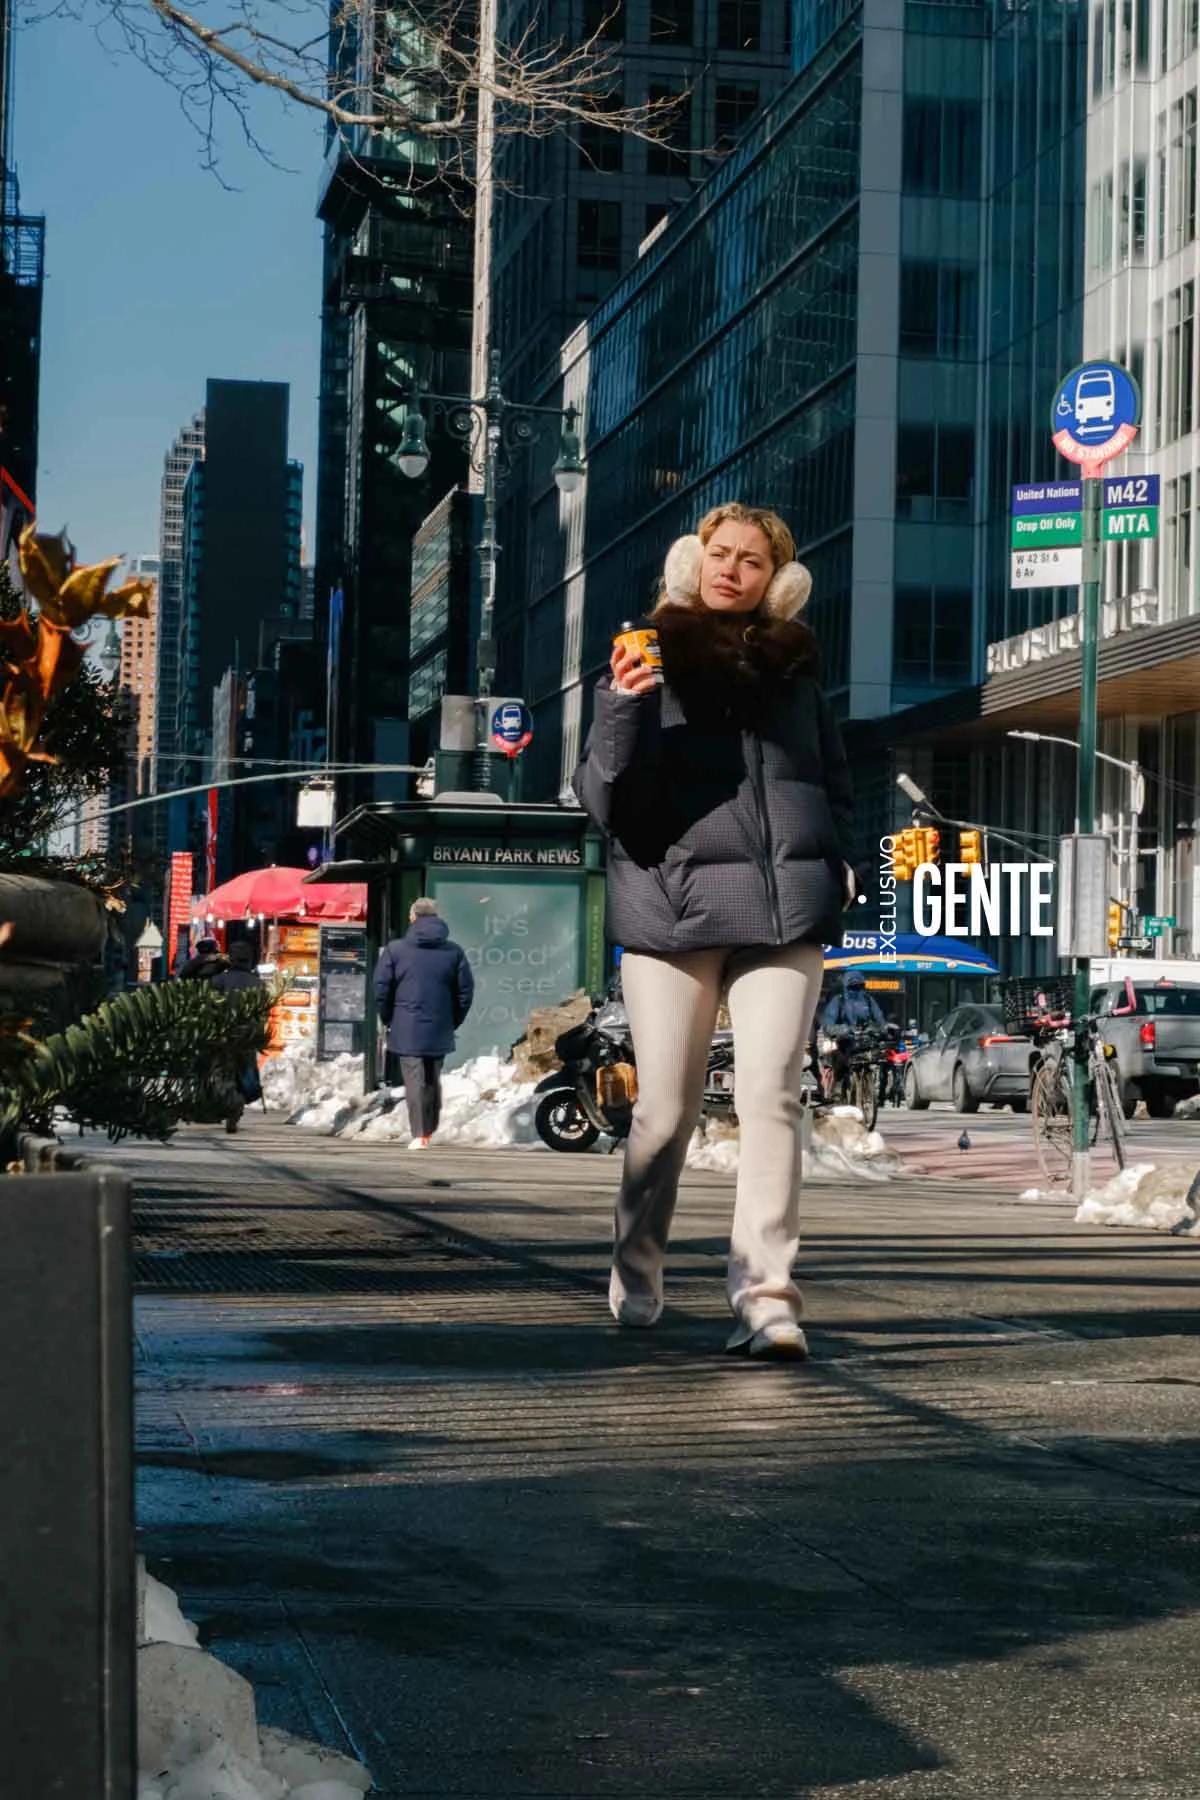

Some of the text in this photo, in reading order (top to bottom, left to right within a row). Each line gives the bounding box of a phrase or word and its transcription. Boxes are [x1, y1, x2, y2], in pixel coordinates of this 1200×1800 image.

[1016, 487, 1080, 501] United Nations
[1107, 479, 1149, 504] M42
[1016, 518, 1077, 533] Drop Off Only
[1108, 513, 1150, 535] MTA
[1016, 555, 1024, 565] W
[1027, 554, 1038, 563] 42
[1040, 553, 1050, 563] St
[1023, 567, 1035, 577] Av
[432, 846, 581, 864] BRYANT PARK NEWS
[484, 914, 529, 937] It's
[842, 931, 877, 950] bus
[466, 944, 548, 969] good
[498, 976, 556, 994] see
